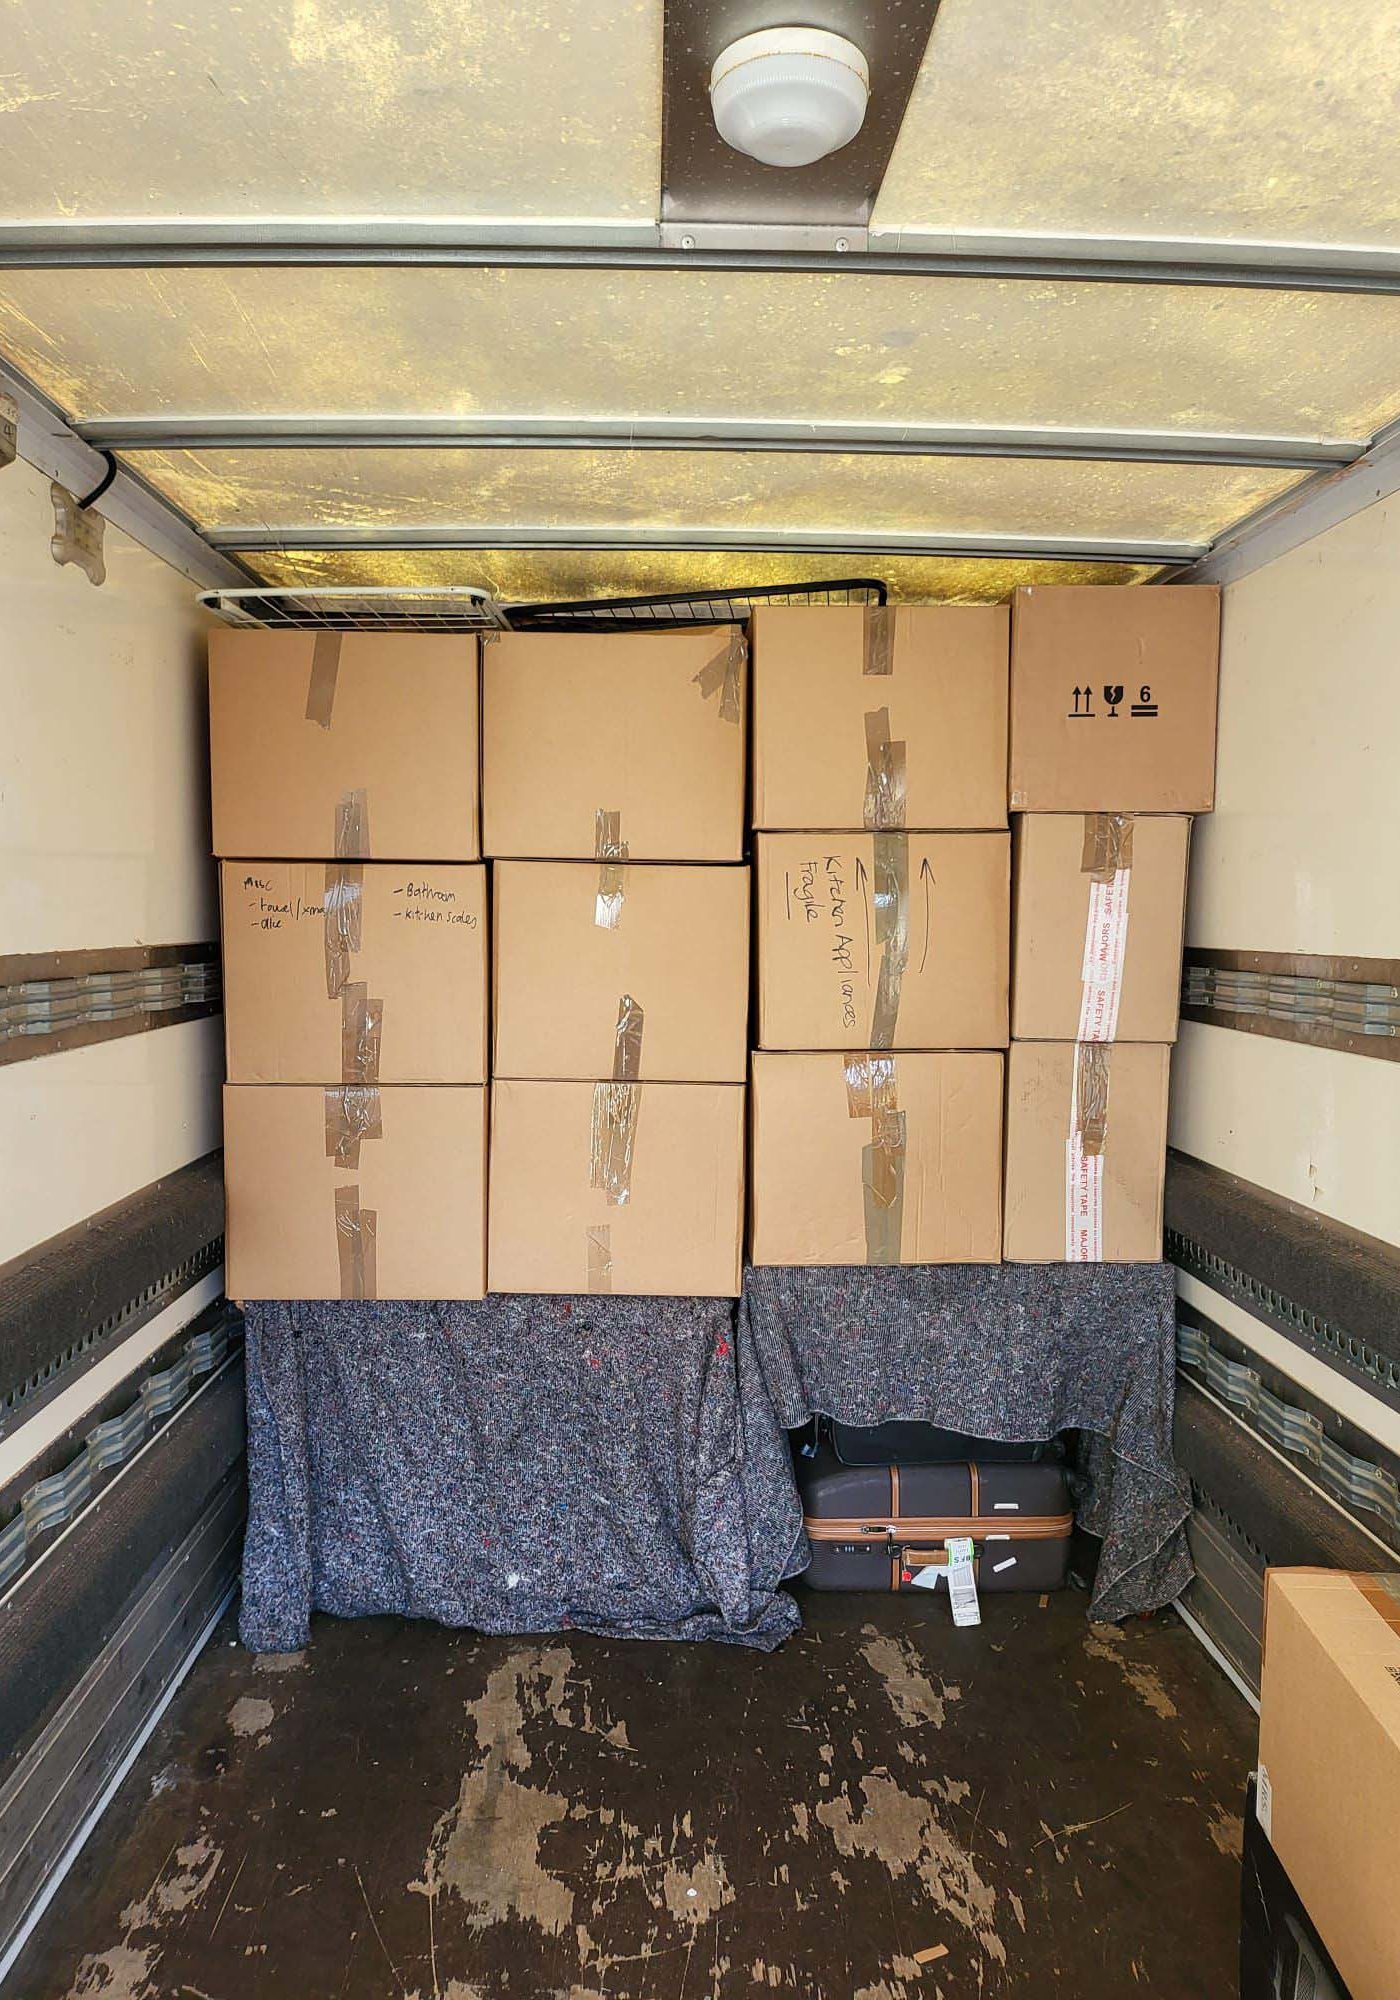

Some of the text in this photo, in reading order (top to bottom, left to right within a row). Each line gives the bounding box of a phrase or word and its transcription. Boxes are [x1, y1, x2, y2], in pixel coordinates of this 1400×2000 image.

[1139, 685, 1151, 703] 6
[793, 861, 826, 923] Fragile
[823, 855, 847, 927] Kitchen
[1094, 989, 1107, 1026] SAFETY
[1090, 1026, 1101, 1042] TA
[1080, 1156, 1088, 1262] SAFETY TAPE MAJOR
